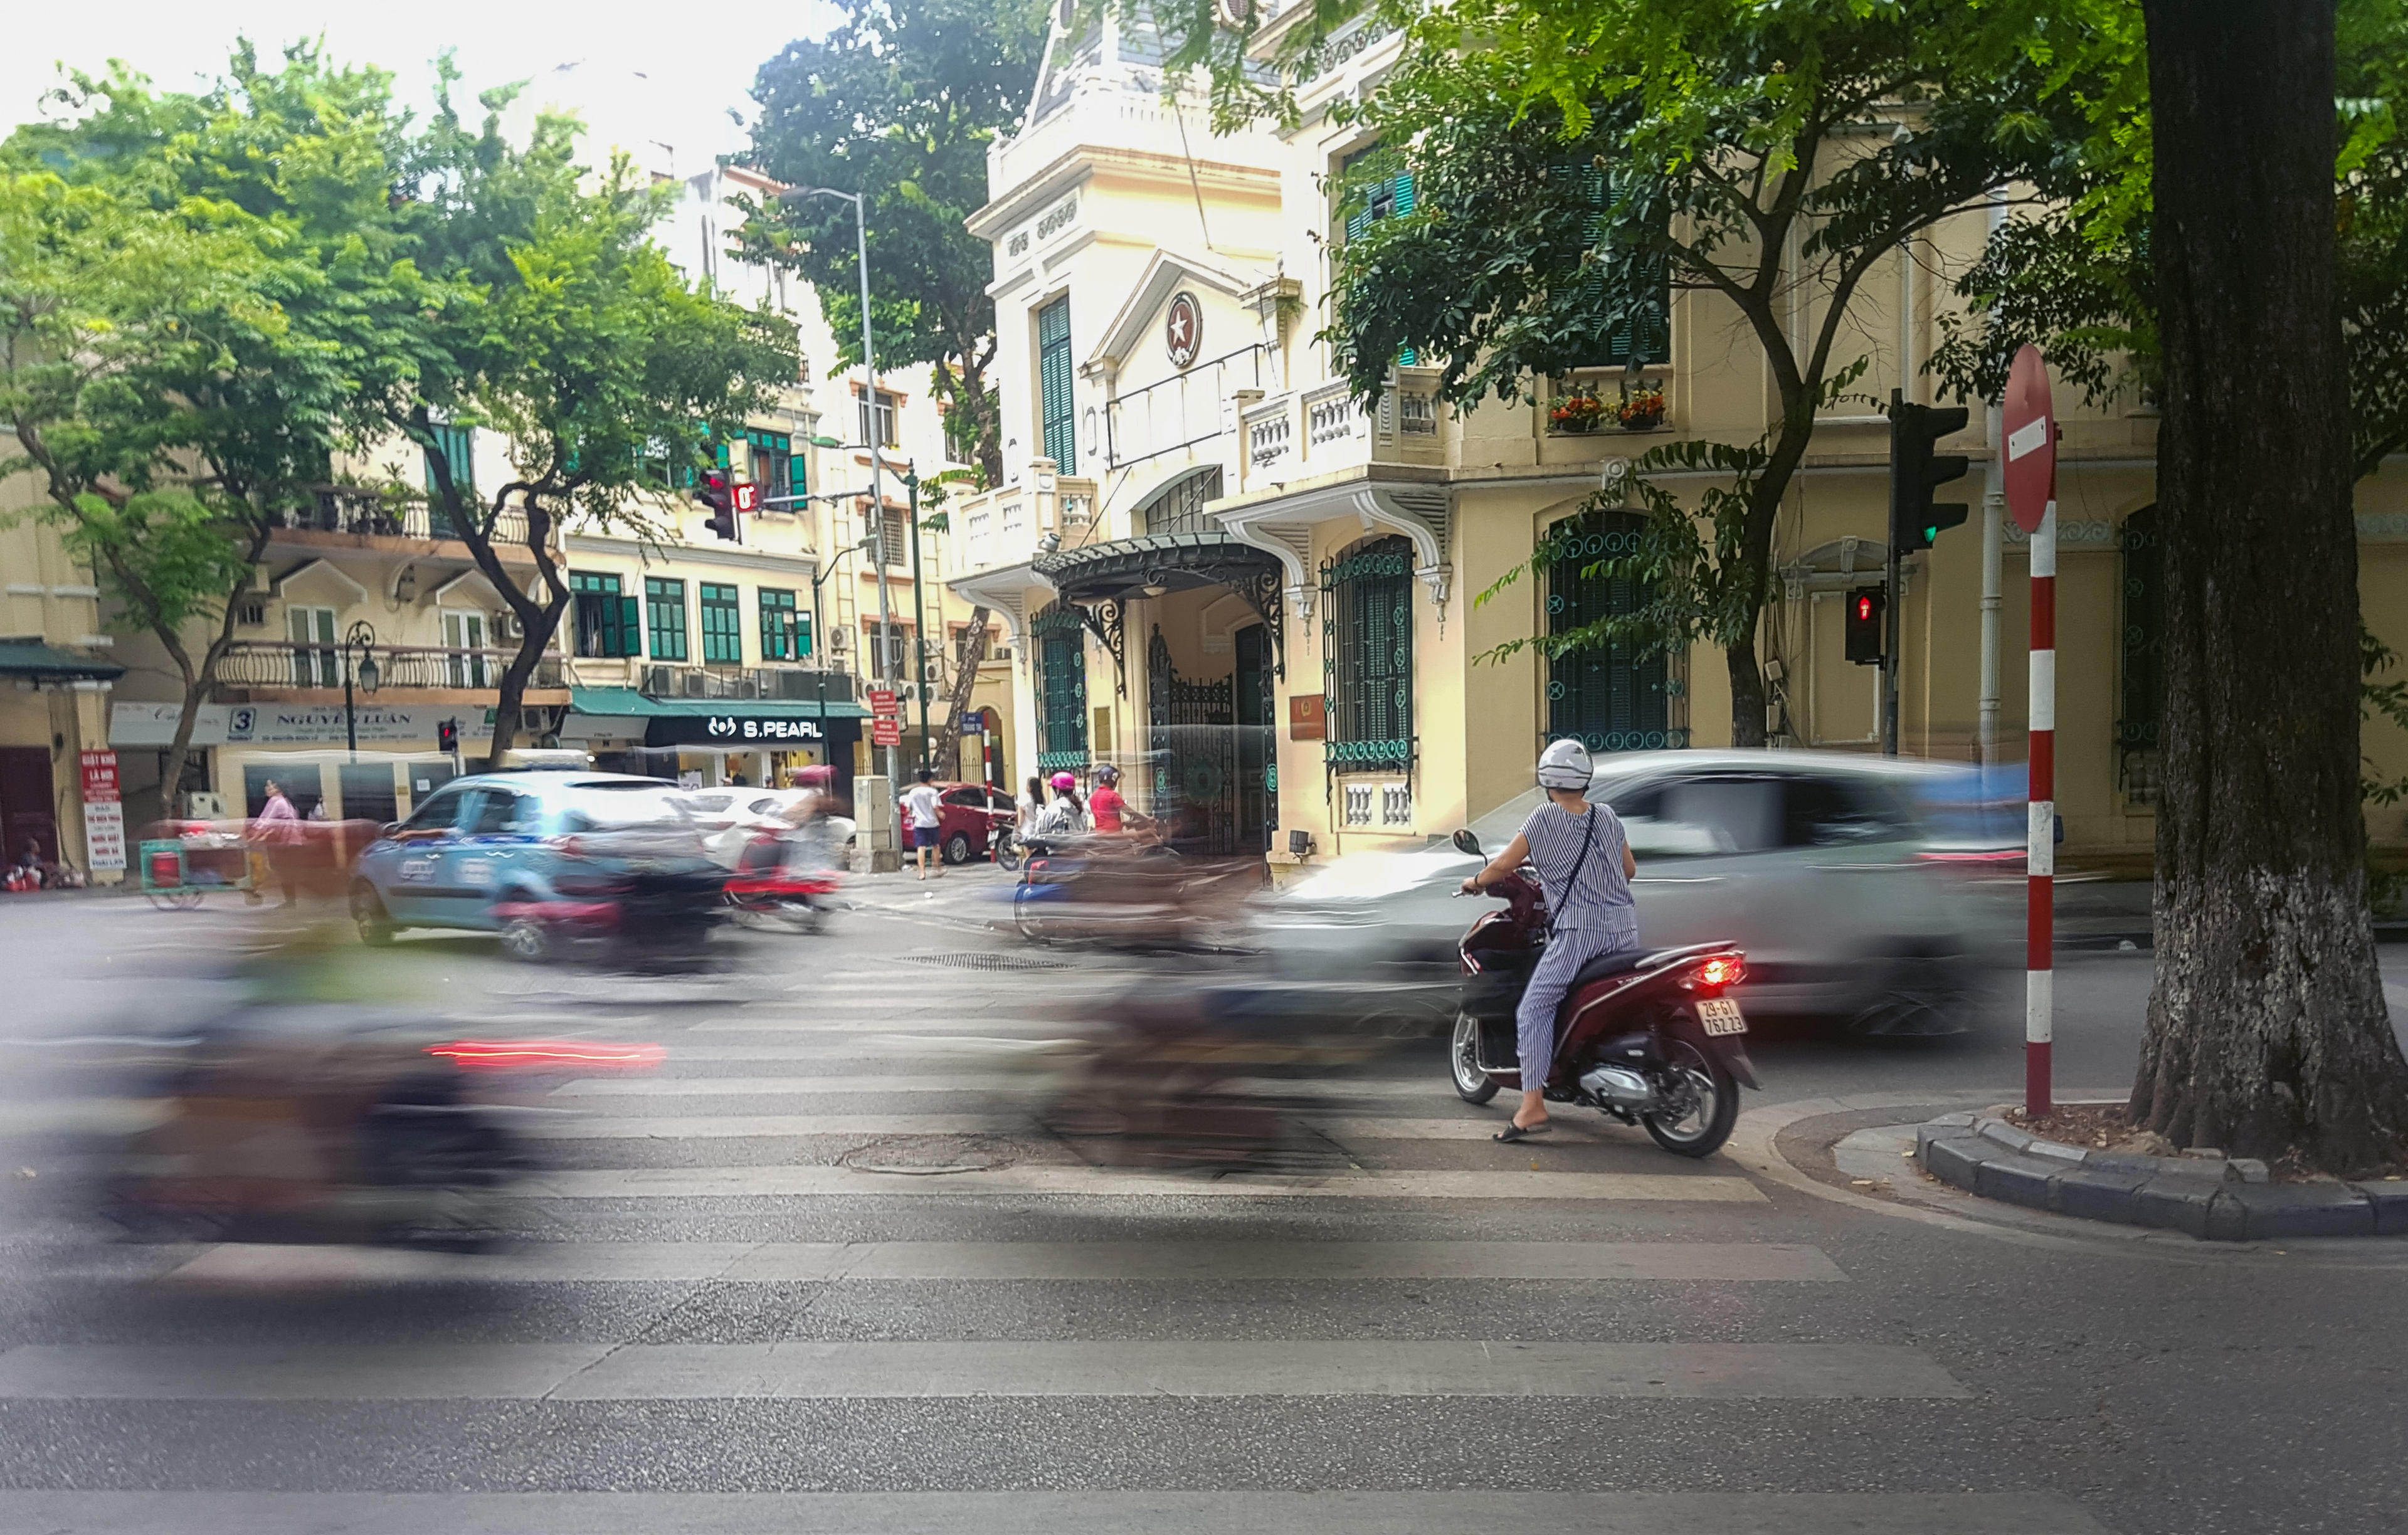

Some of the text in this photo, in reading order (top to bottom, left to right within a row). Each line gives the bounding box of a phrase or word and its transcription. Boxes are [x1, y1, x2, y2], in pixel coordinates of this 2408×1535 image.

[235, 710, 251, 730] 3
[744, 720, 823, 737] S.PEARL
[1702, 1001, 1734, 1016] 29-G1
